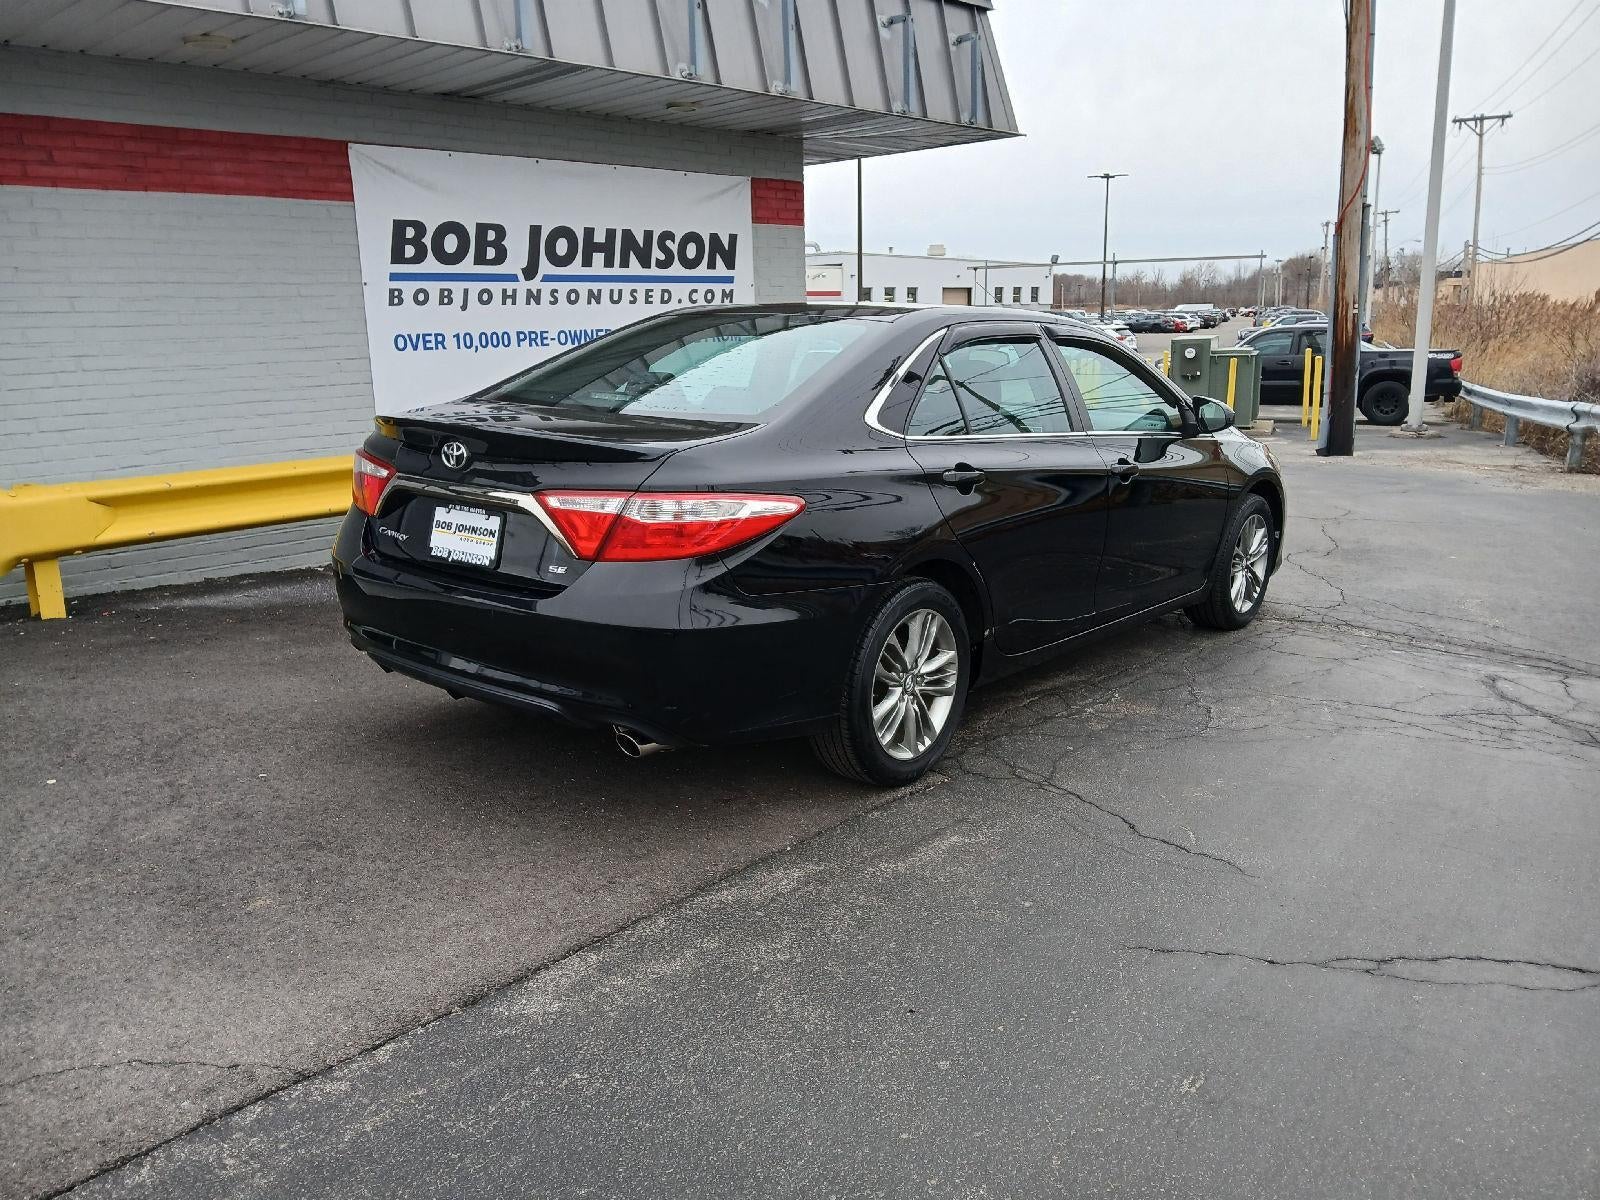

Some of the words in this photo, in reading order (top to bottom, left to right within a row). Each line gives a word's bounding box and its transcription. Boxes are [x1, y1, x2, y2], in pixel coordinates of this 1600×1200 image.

[390, 219, 507, 266] BOB
[520, 225, 738, 281] JOHNSON
[388, 287, 735, 311] BOBJOHNSONUSED.COM
[393, 333, 447, 351] OVER
[453, 331, 511, 353] 10,000
[434, 520, 453, 531] BOB
[453, 522, 497, 538] JOHNSON
[431, 545, 449, 558] BOB
[448, 548, 490, 567] JOHNSON
[548, 565, 568, 574] SE
